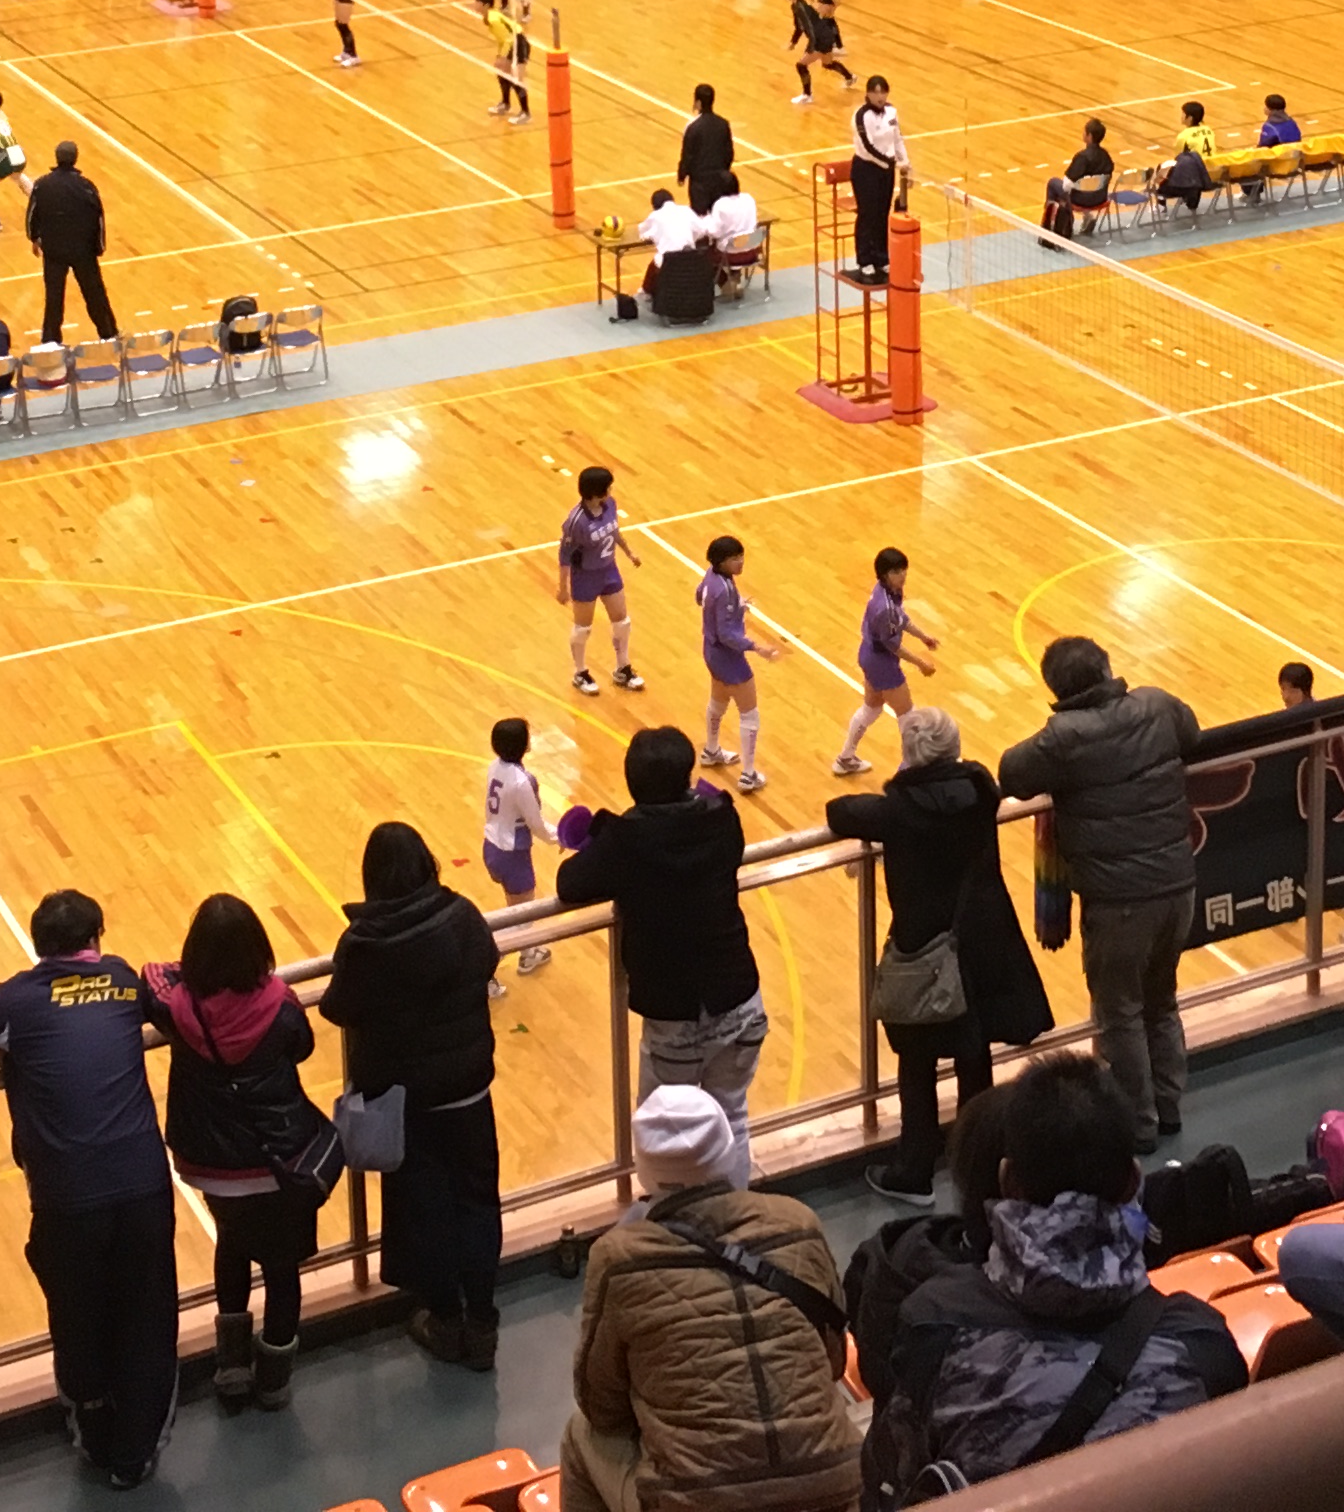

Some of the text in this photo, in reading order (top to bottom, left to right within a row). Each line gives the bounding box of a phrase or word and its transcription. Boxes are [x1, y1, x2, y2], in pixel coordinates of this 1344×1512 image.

[600, 534, 614, 559] 2
[487, 777, 504, 815] 5
[51, 974, 112, 1003] PRO
[59, 987, 137, 1008] STATUS
